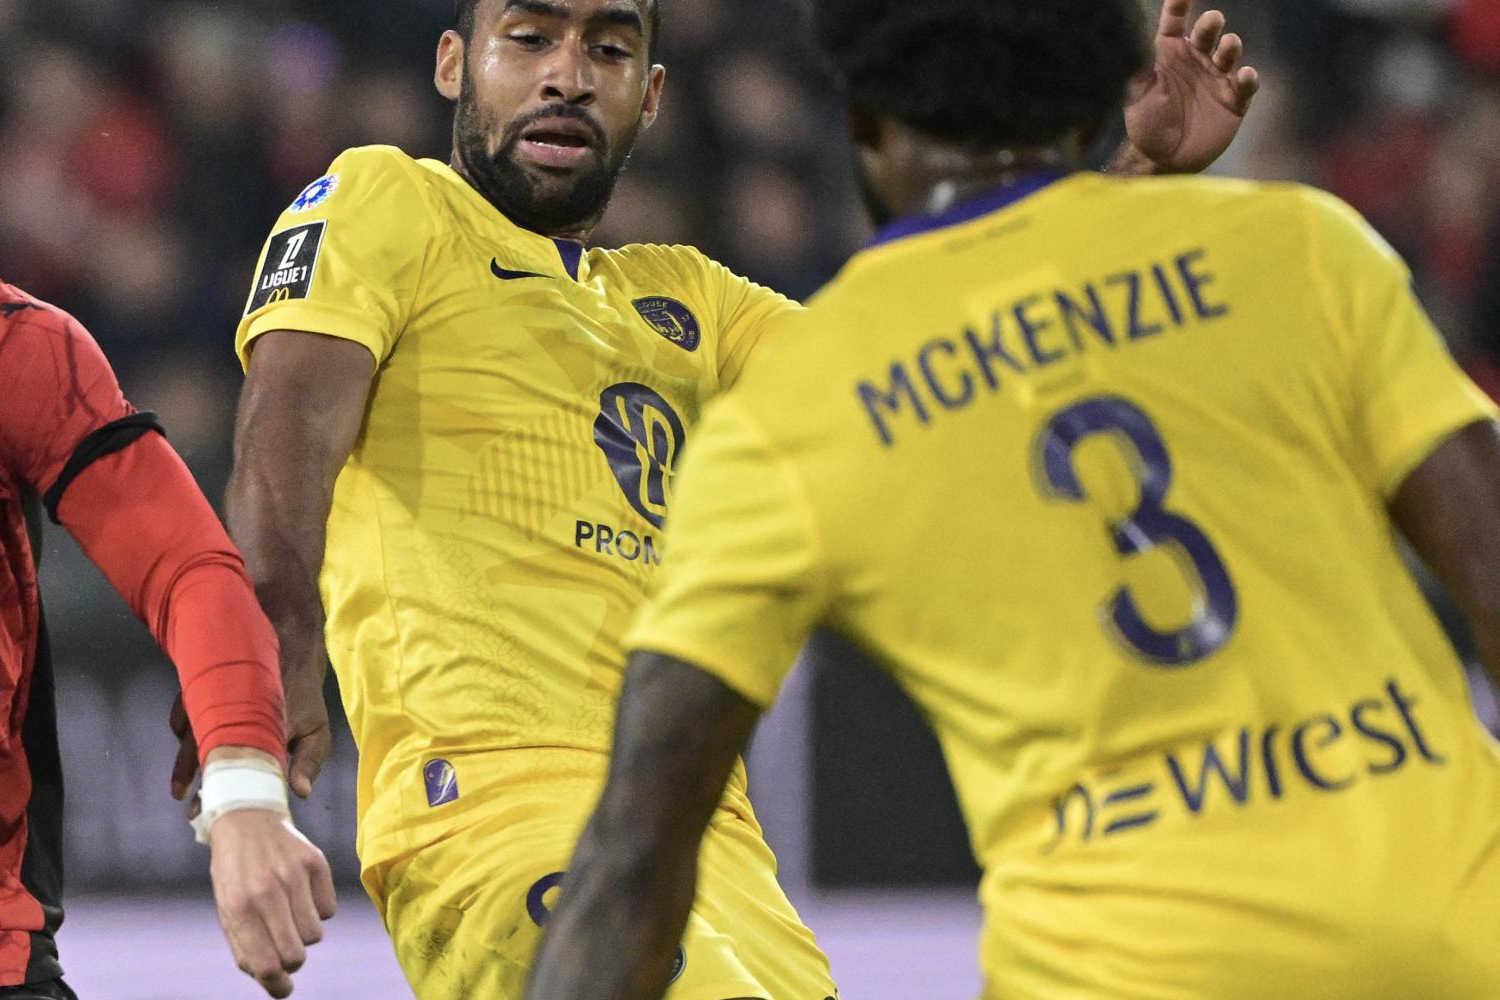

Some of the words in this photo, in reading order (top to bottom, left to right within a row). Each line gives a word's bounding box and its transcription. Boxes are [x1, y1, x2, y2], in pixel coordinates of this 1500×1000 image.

[261, 266, 300, 290] LIGUE
[856, 249, 1229, 446] MCKENZIE
[1028, 393, 1238, 668] 3
